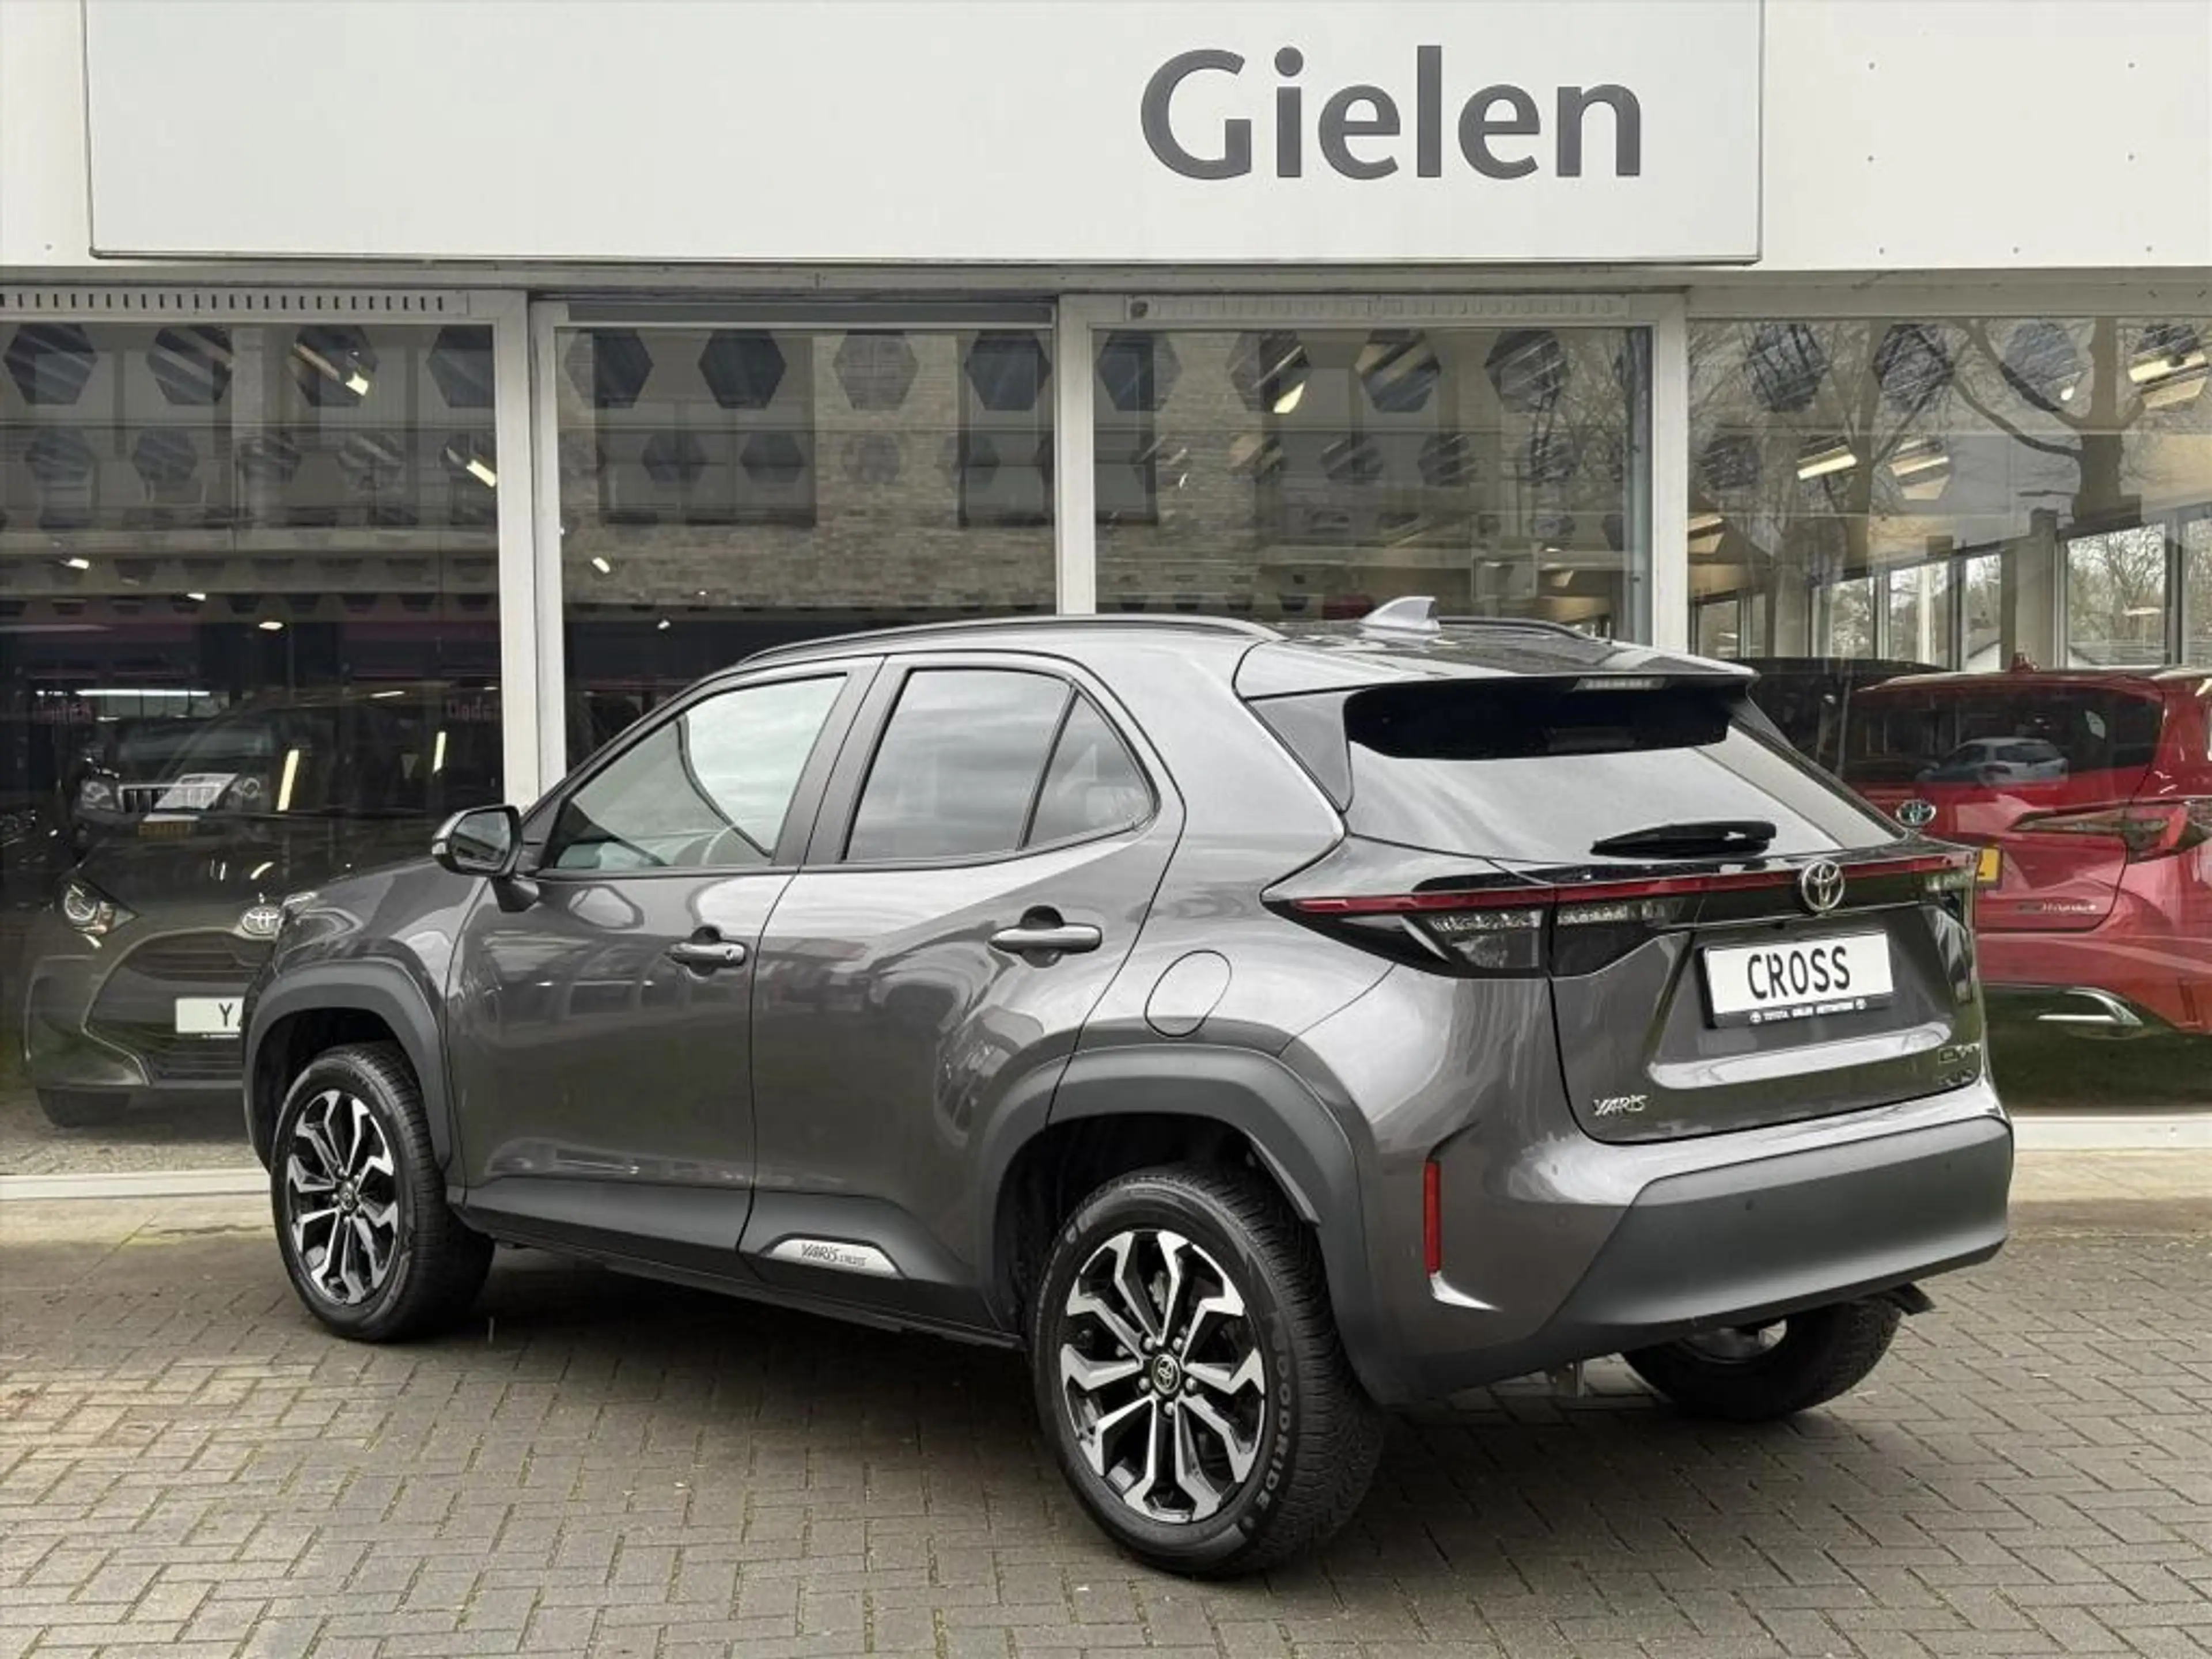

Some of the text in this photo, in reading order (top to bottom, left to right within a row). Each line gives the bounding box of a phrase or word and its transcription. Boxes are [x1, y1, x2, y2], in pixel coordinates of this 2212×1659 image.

[1140, 44, 1641, 180] Gielen
[1747, 946, 1850, 999] CROSS
[218, 1002, 241, 1027] Y
[1592, 1094, 1649, 1116] YARIS
[801, 1243, 841, 1263] YARIS
